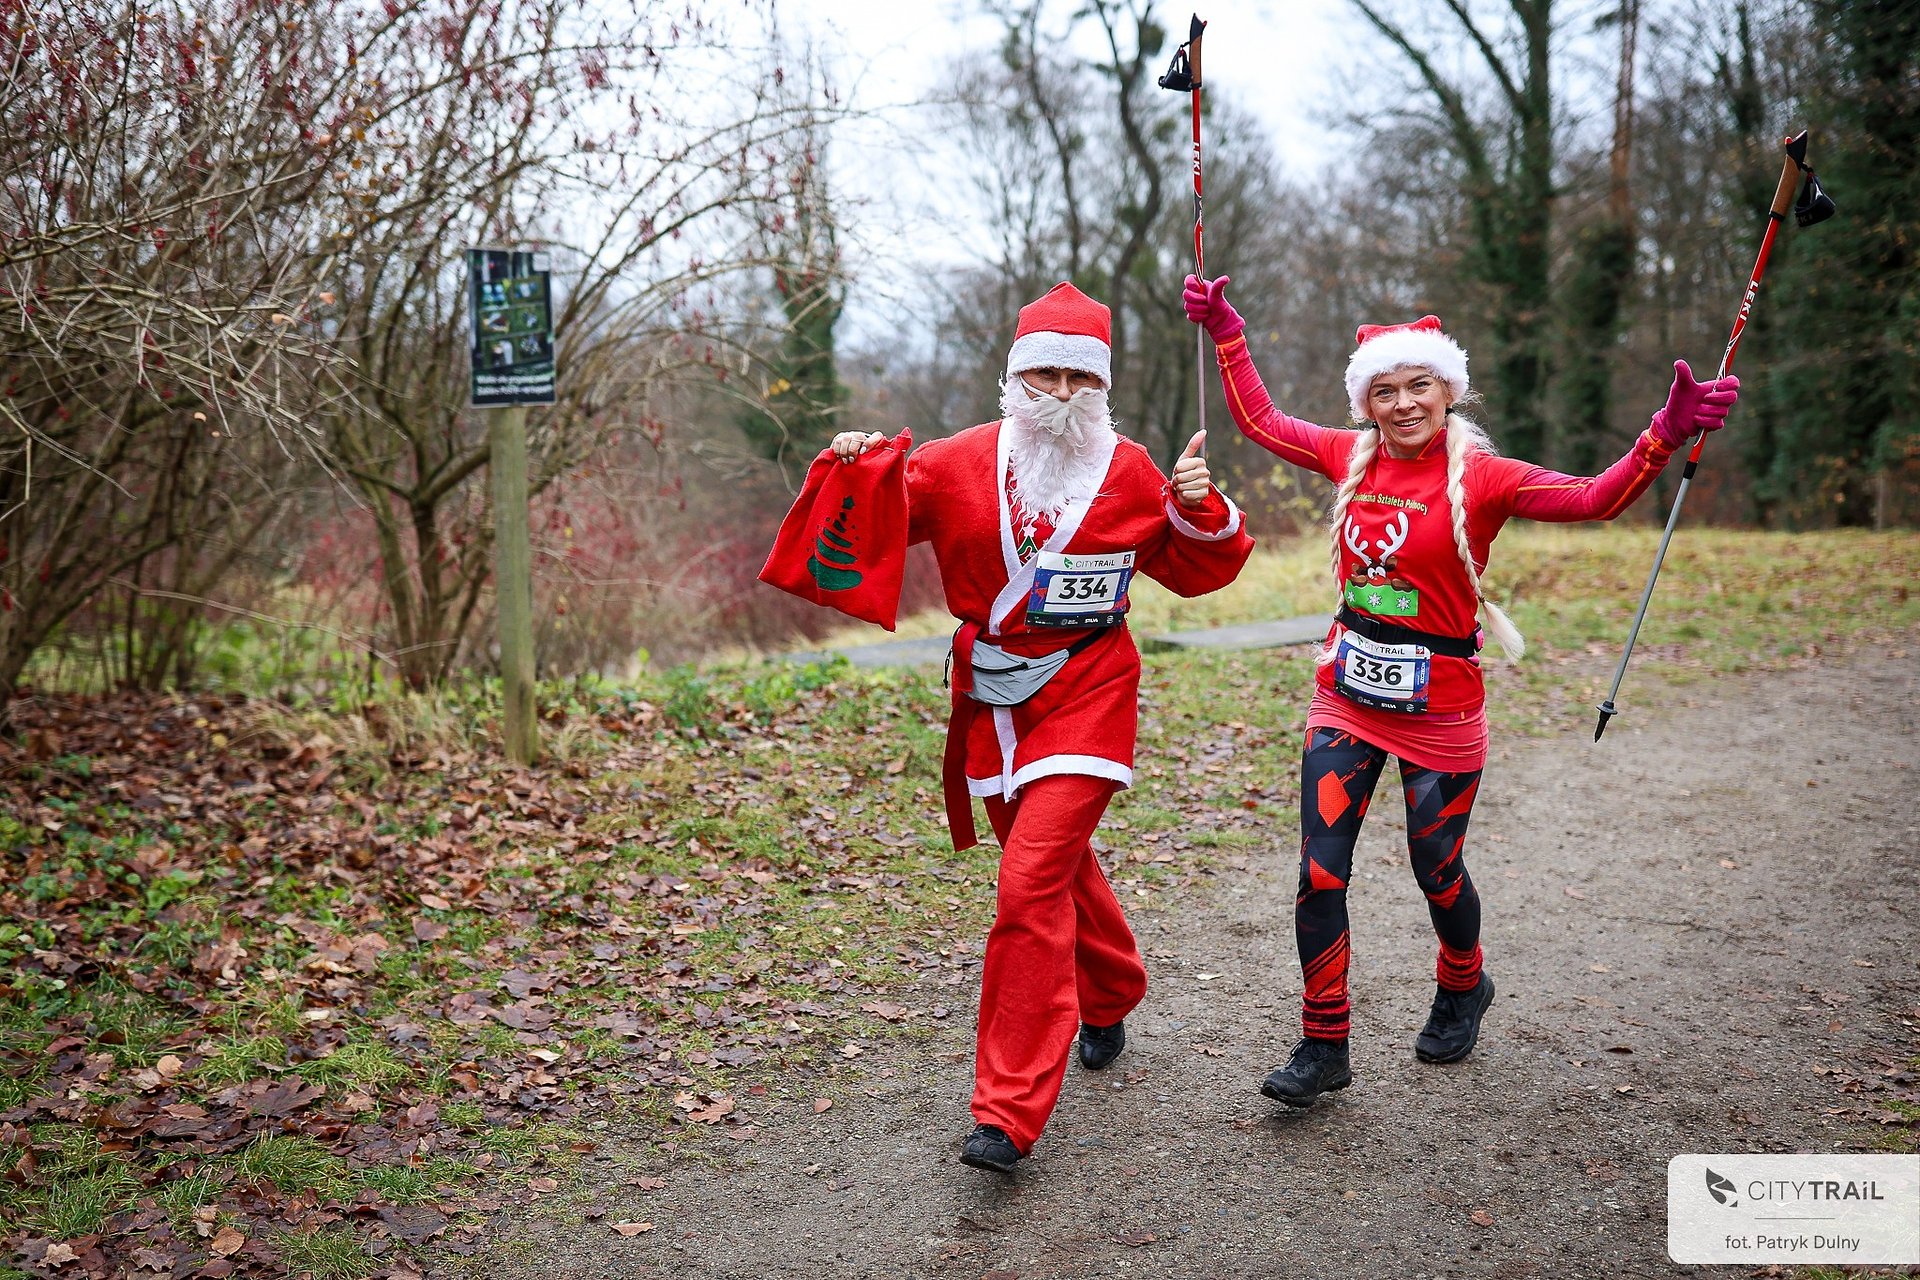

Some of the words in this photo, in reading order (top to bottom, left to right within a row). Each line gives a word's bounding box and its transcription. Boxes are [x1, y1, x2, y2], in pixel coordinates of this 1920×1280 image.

[1740, 280, 1759, 321] LEKI
[1377, 493, 1404, 507] Sztafeta
[1058, 577, 1109, 600] 334
[1353, 654, 1402, 686] 336
